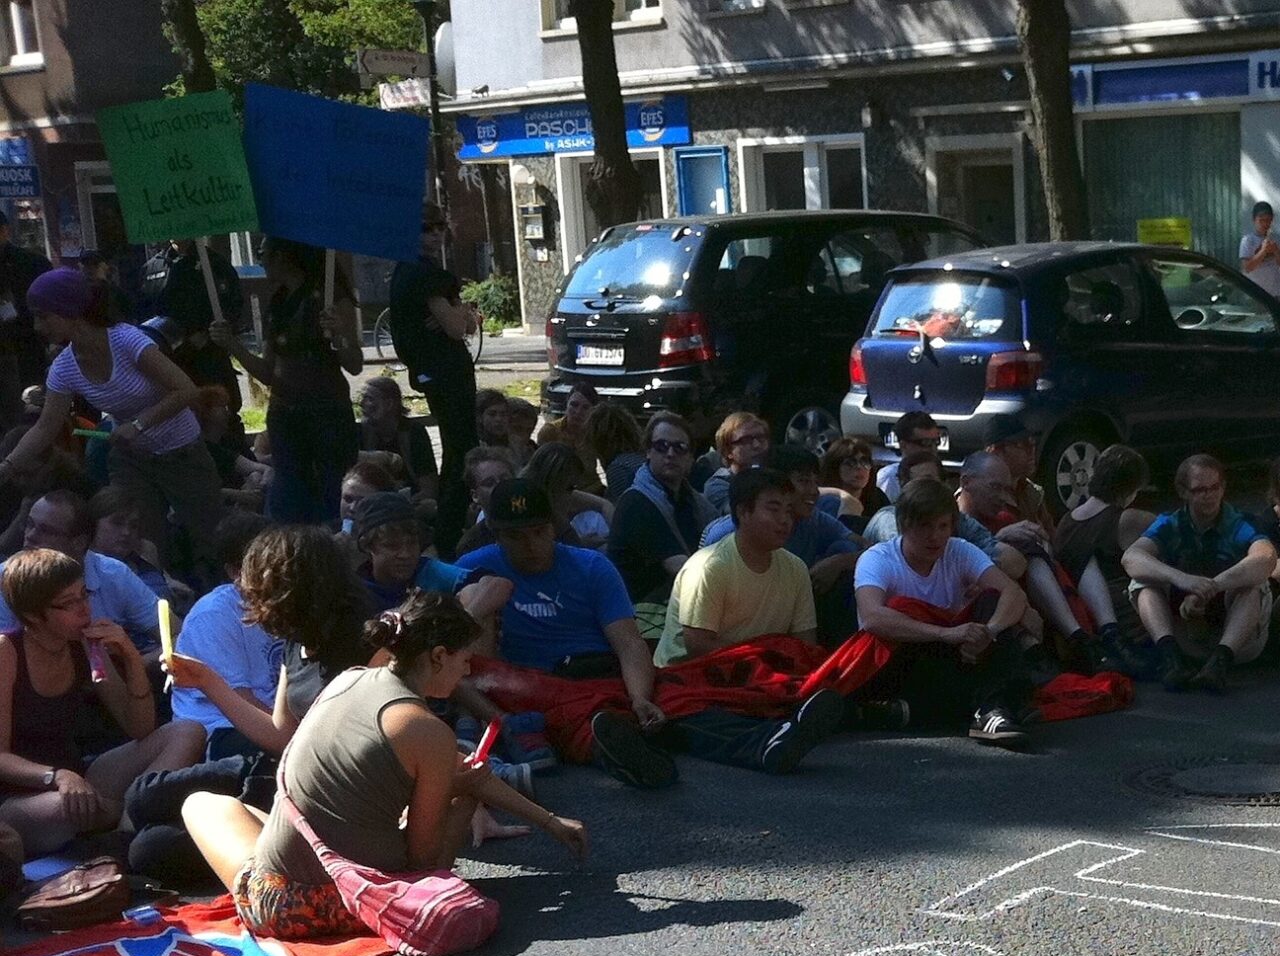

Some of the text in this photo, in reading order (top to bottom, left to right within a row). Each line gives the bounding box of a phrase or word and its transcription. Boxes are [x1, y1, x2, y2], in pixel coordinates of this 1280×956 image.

[121, 109, 231, 143] Humanismus
[641, 110, 663, 126] EFES
[477, 125, 497, 139] EFES
[168, 148, 193, 172] als
[143, 176, 242, 216] Leitkultur
